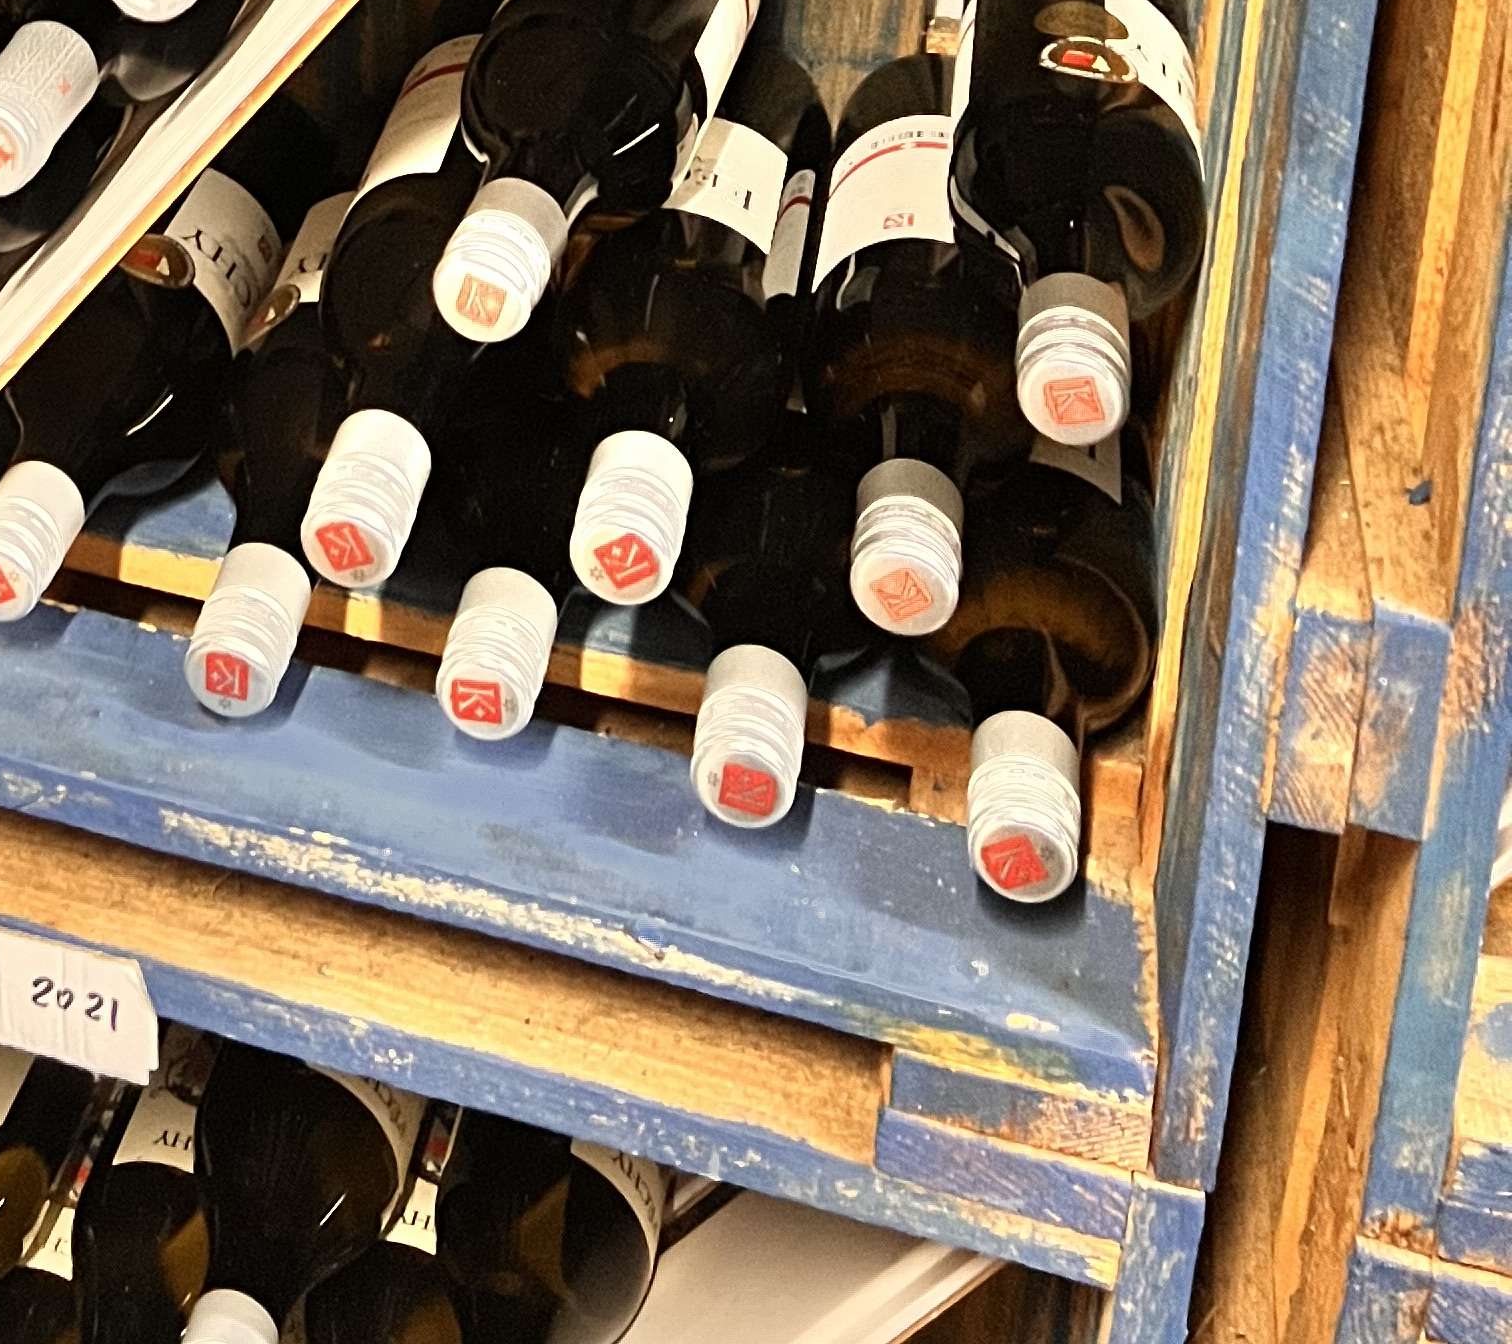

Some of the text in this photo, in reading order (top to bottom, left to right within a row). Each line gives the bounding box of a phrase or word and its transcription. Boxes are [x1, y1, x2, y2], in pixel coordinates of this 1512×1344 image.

[319, 524, 368, 568] K
[600, 538, 655, 586] K
[208, 654, 249, 698] K
[454, 680, 500, 721] K
[32, 976, 119, 1032] 2021
